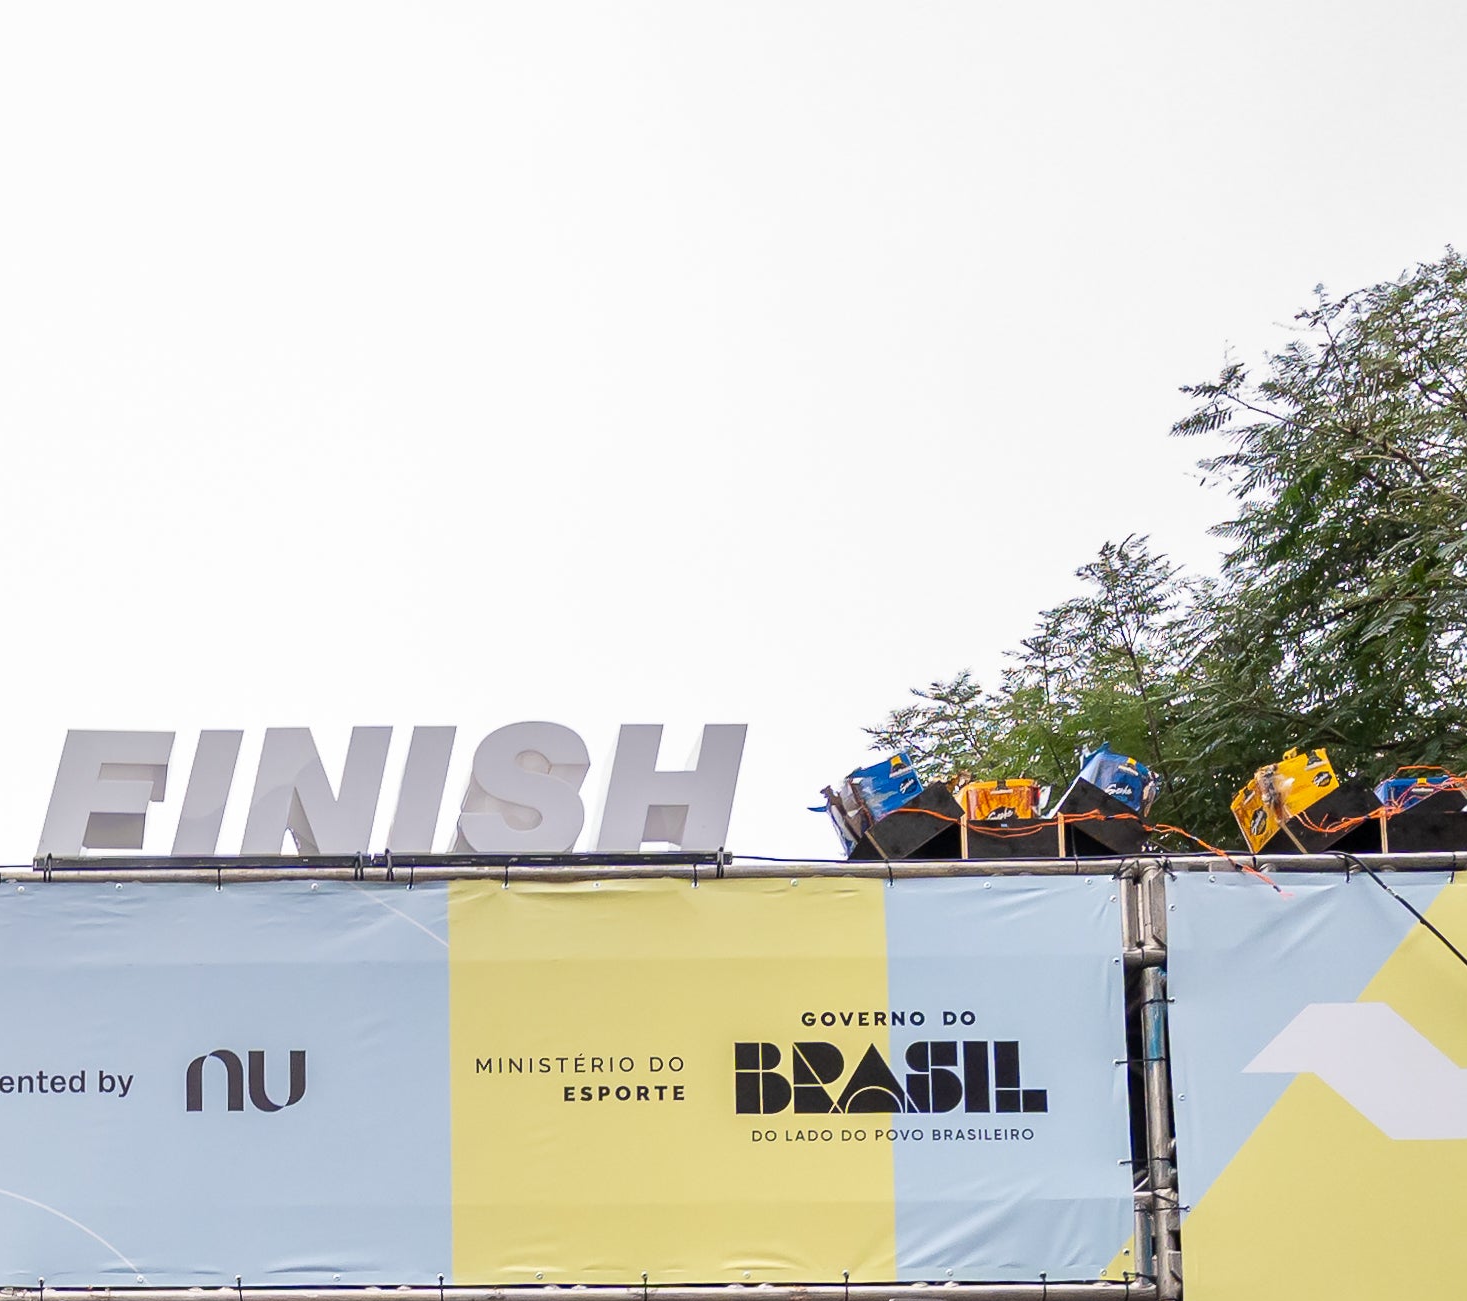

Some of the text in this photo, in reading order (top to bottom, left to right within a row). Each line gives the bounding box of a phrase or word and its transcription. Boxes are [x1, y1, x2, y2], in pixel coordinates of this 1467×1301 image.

[38, 722, 750, 858] FINISH
[801, 1011, 977, 1027] GOVERNO DO
[475, 1052, 686, 1075] MINISTÉRIO DO
[98, 1069, 134, 1098] by
[186, 1049, 307, 1112] nu
[734, 1040, 1048, 1115] BRASIL
[564, 1085, 686, 1102] ESPORTE
[751, 1128, 1036, 1143] DO LADO DO POVO BRASILEIRO
